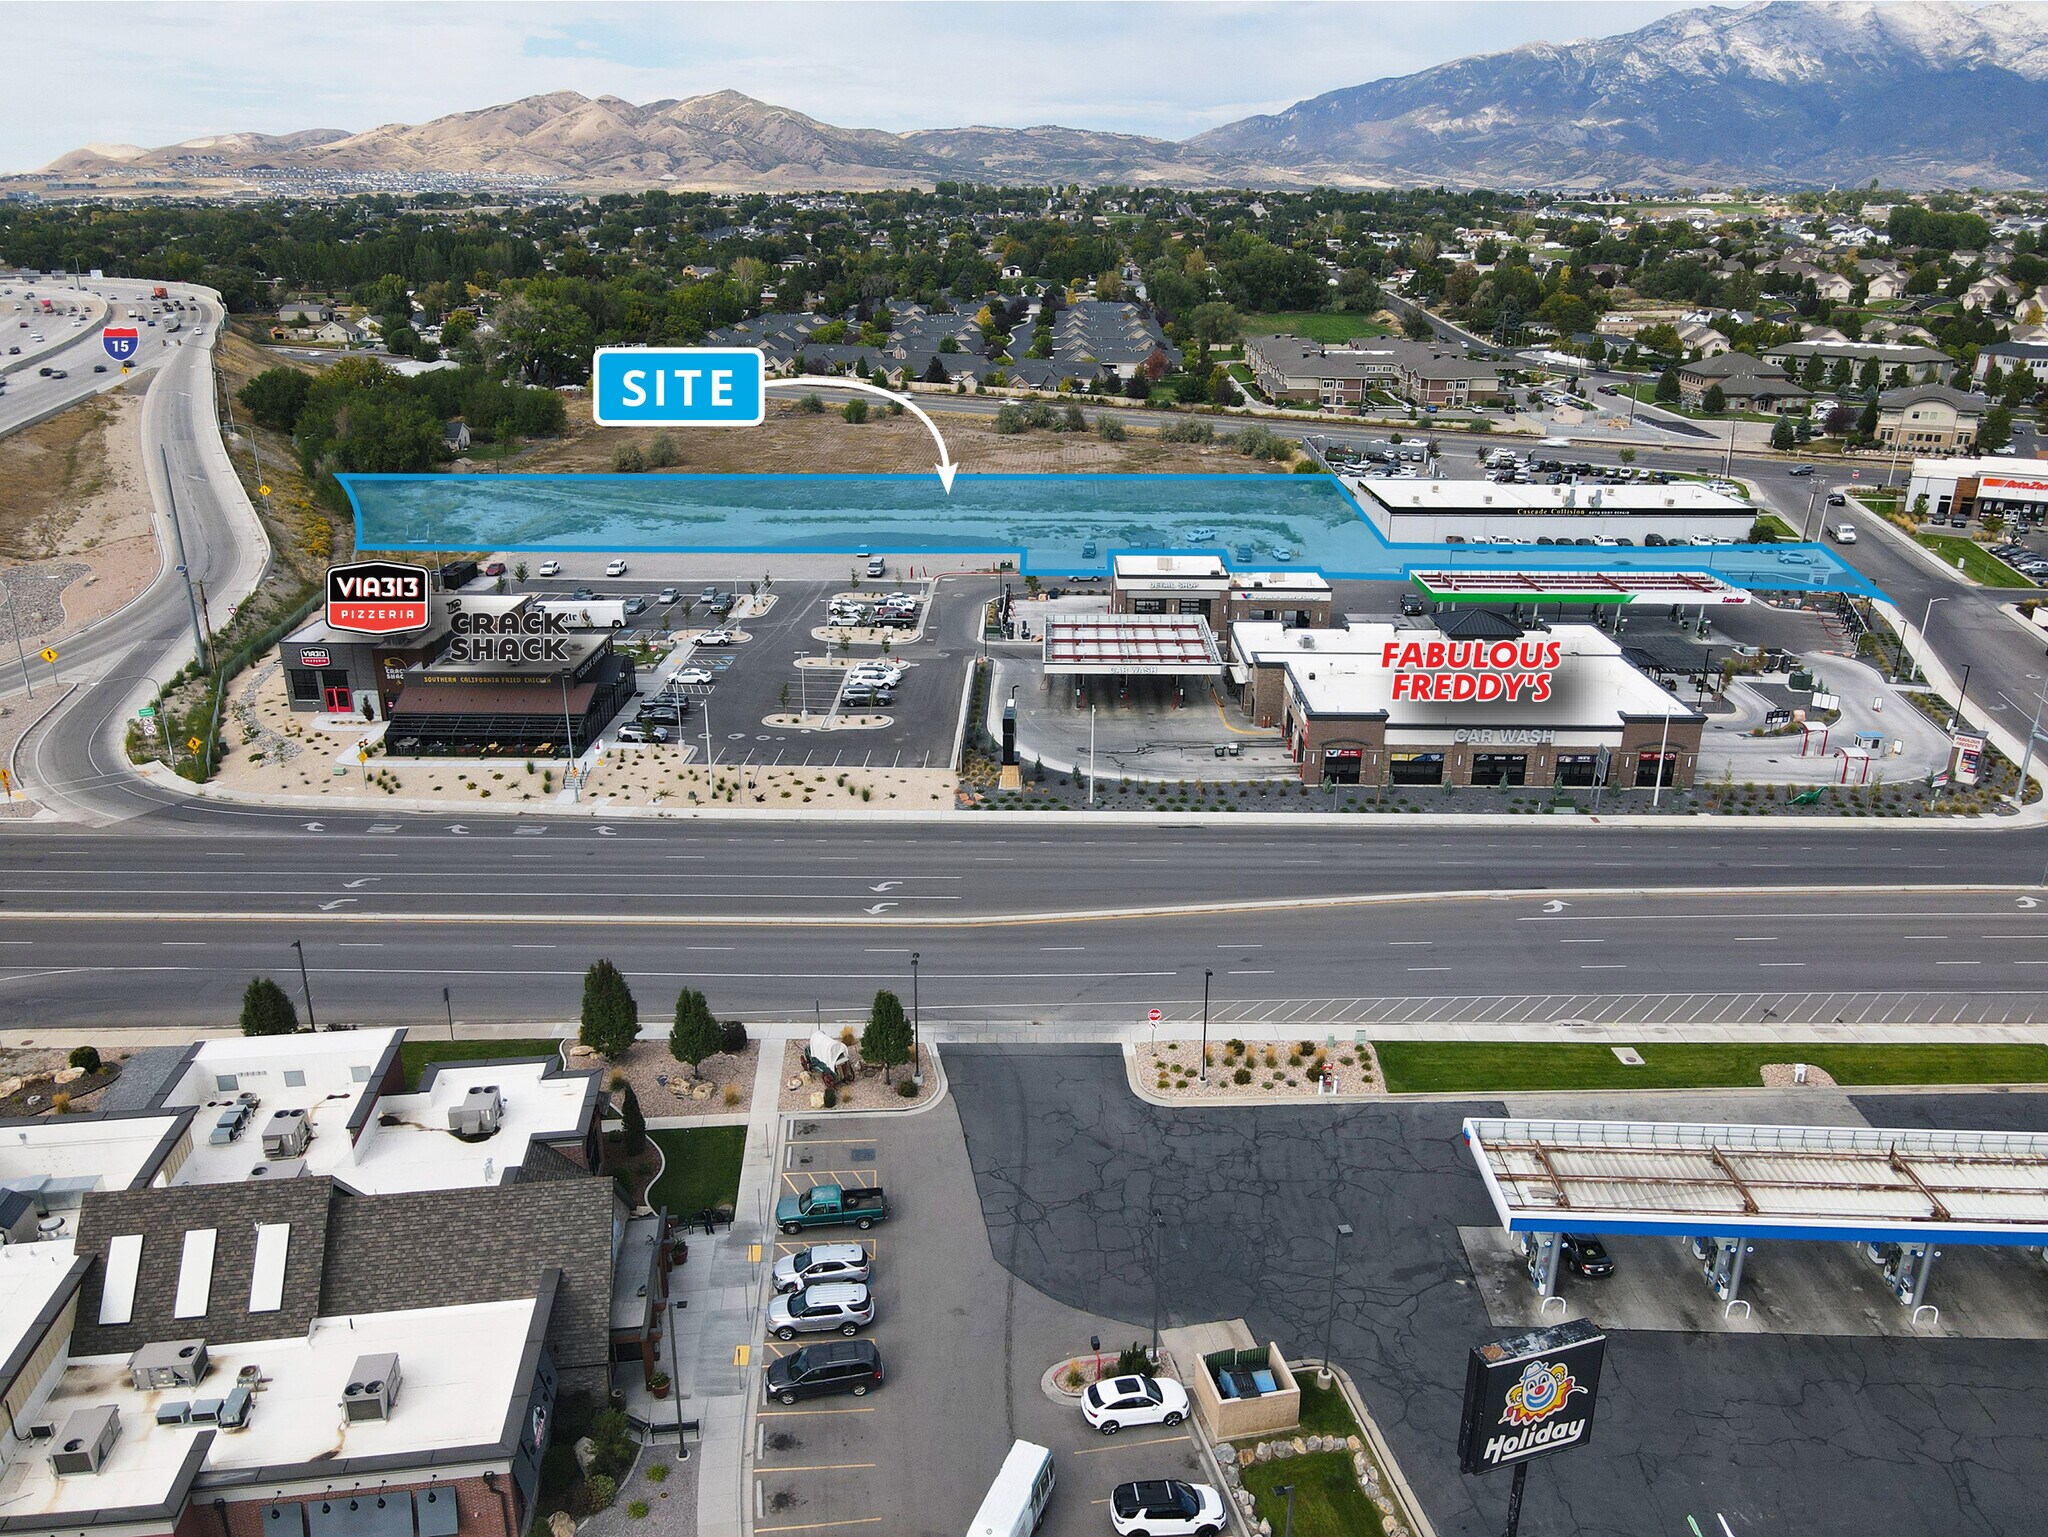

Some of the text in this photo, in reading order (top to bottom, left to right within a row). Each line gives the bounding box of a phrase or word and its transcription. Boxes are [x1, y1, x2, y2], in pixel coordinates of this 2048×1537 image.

[2004, 480, 2048, 491] AutoZon
[1178, 581, 1200, 589] SHOP
[1109, 666, 1158, 675] CAR WASH
[1454, 728, 1556, 744] CAR WASH
[1483, 1419, 1585, 1464] Holiday
